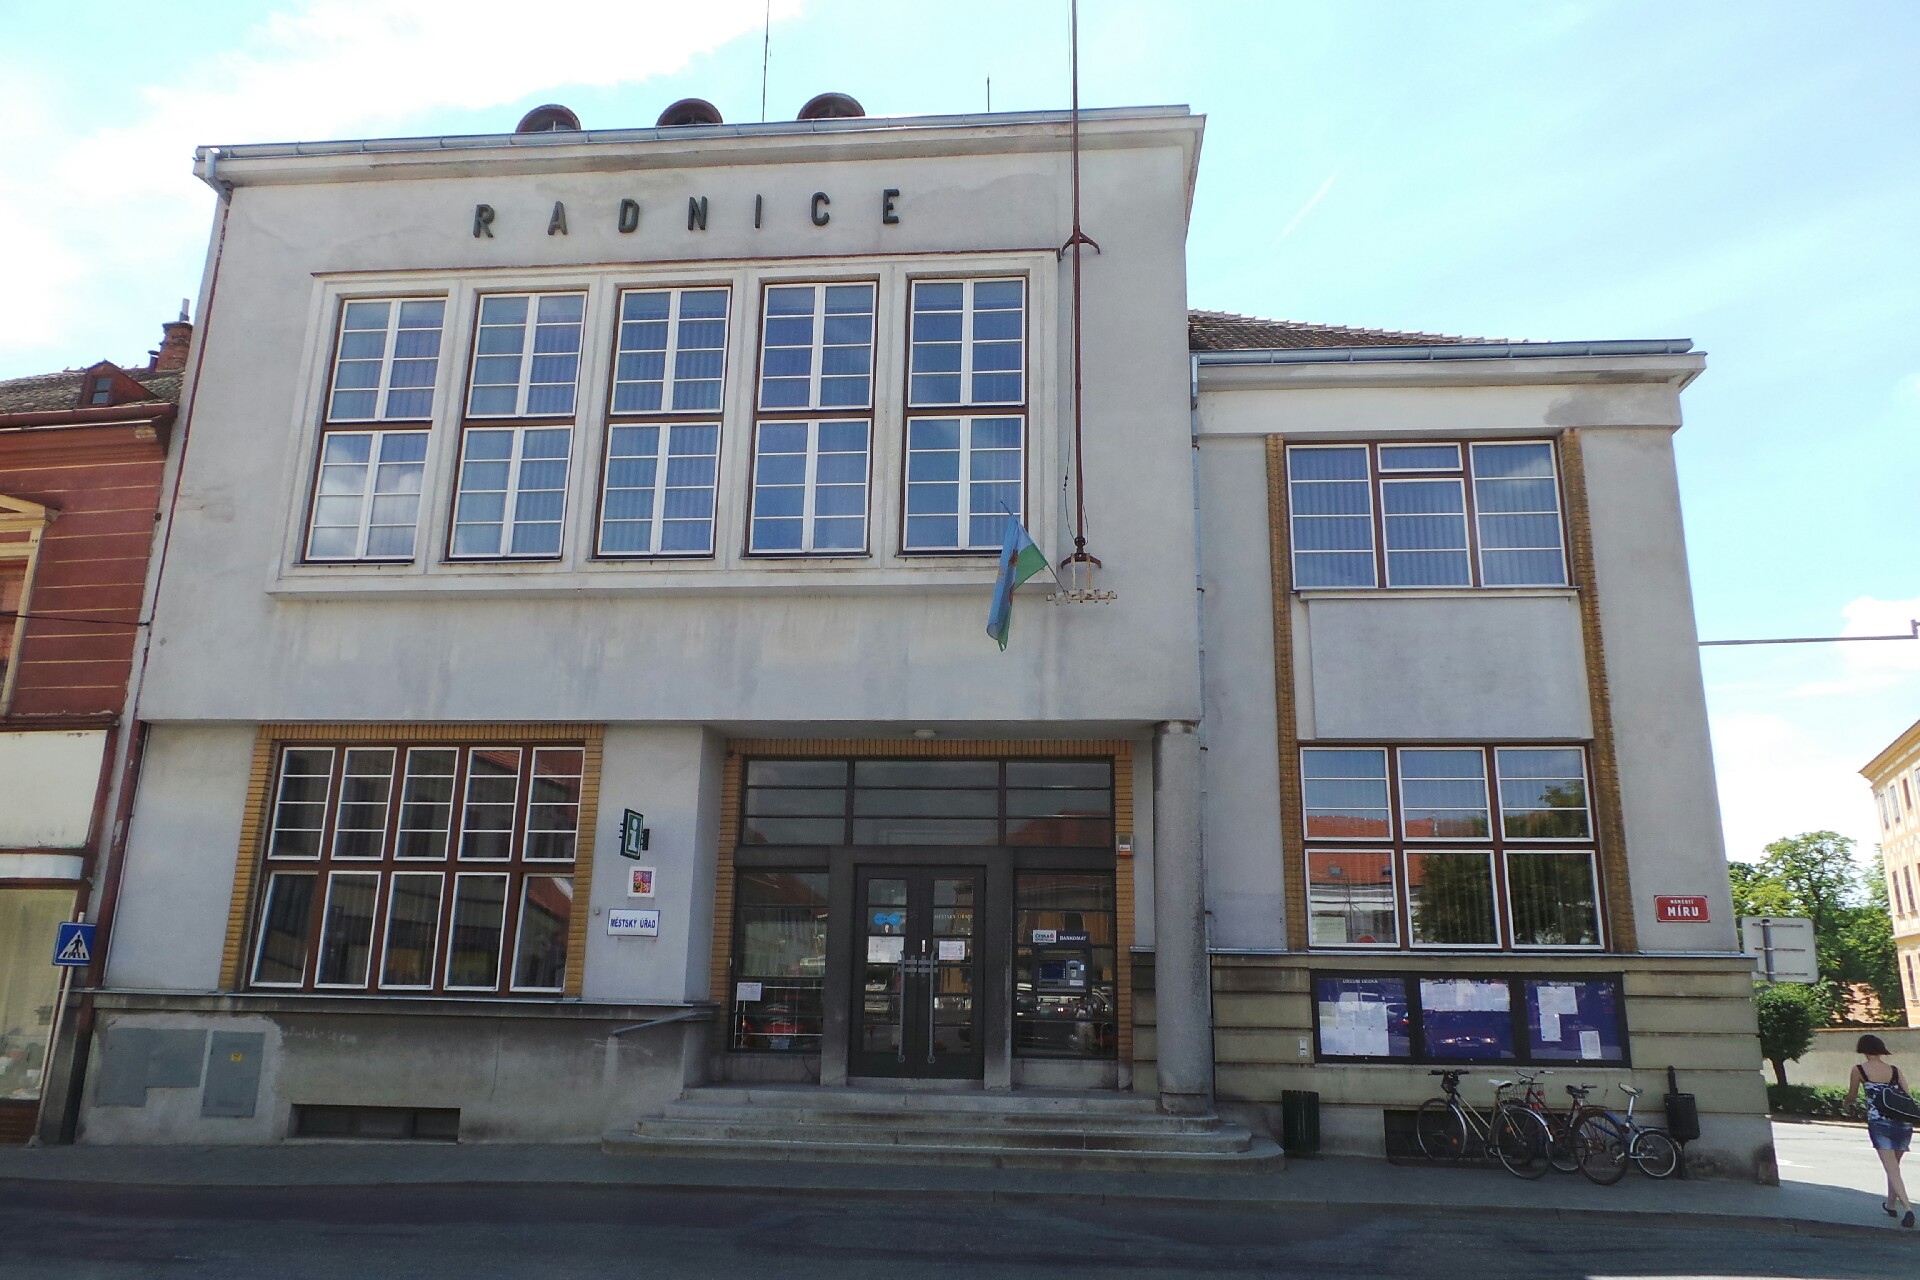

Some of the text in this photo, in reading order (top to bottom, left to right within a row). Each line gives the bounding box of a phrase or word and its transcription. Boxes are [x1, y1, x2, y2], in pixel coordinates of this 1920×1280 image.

[472, 188, 901, 238] RADNICE
[1667, 905, 1699, 917] MÍRU
[610, 917, 656, 928] MĚSTSKÝ ÚŘAD
